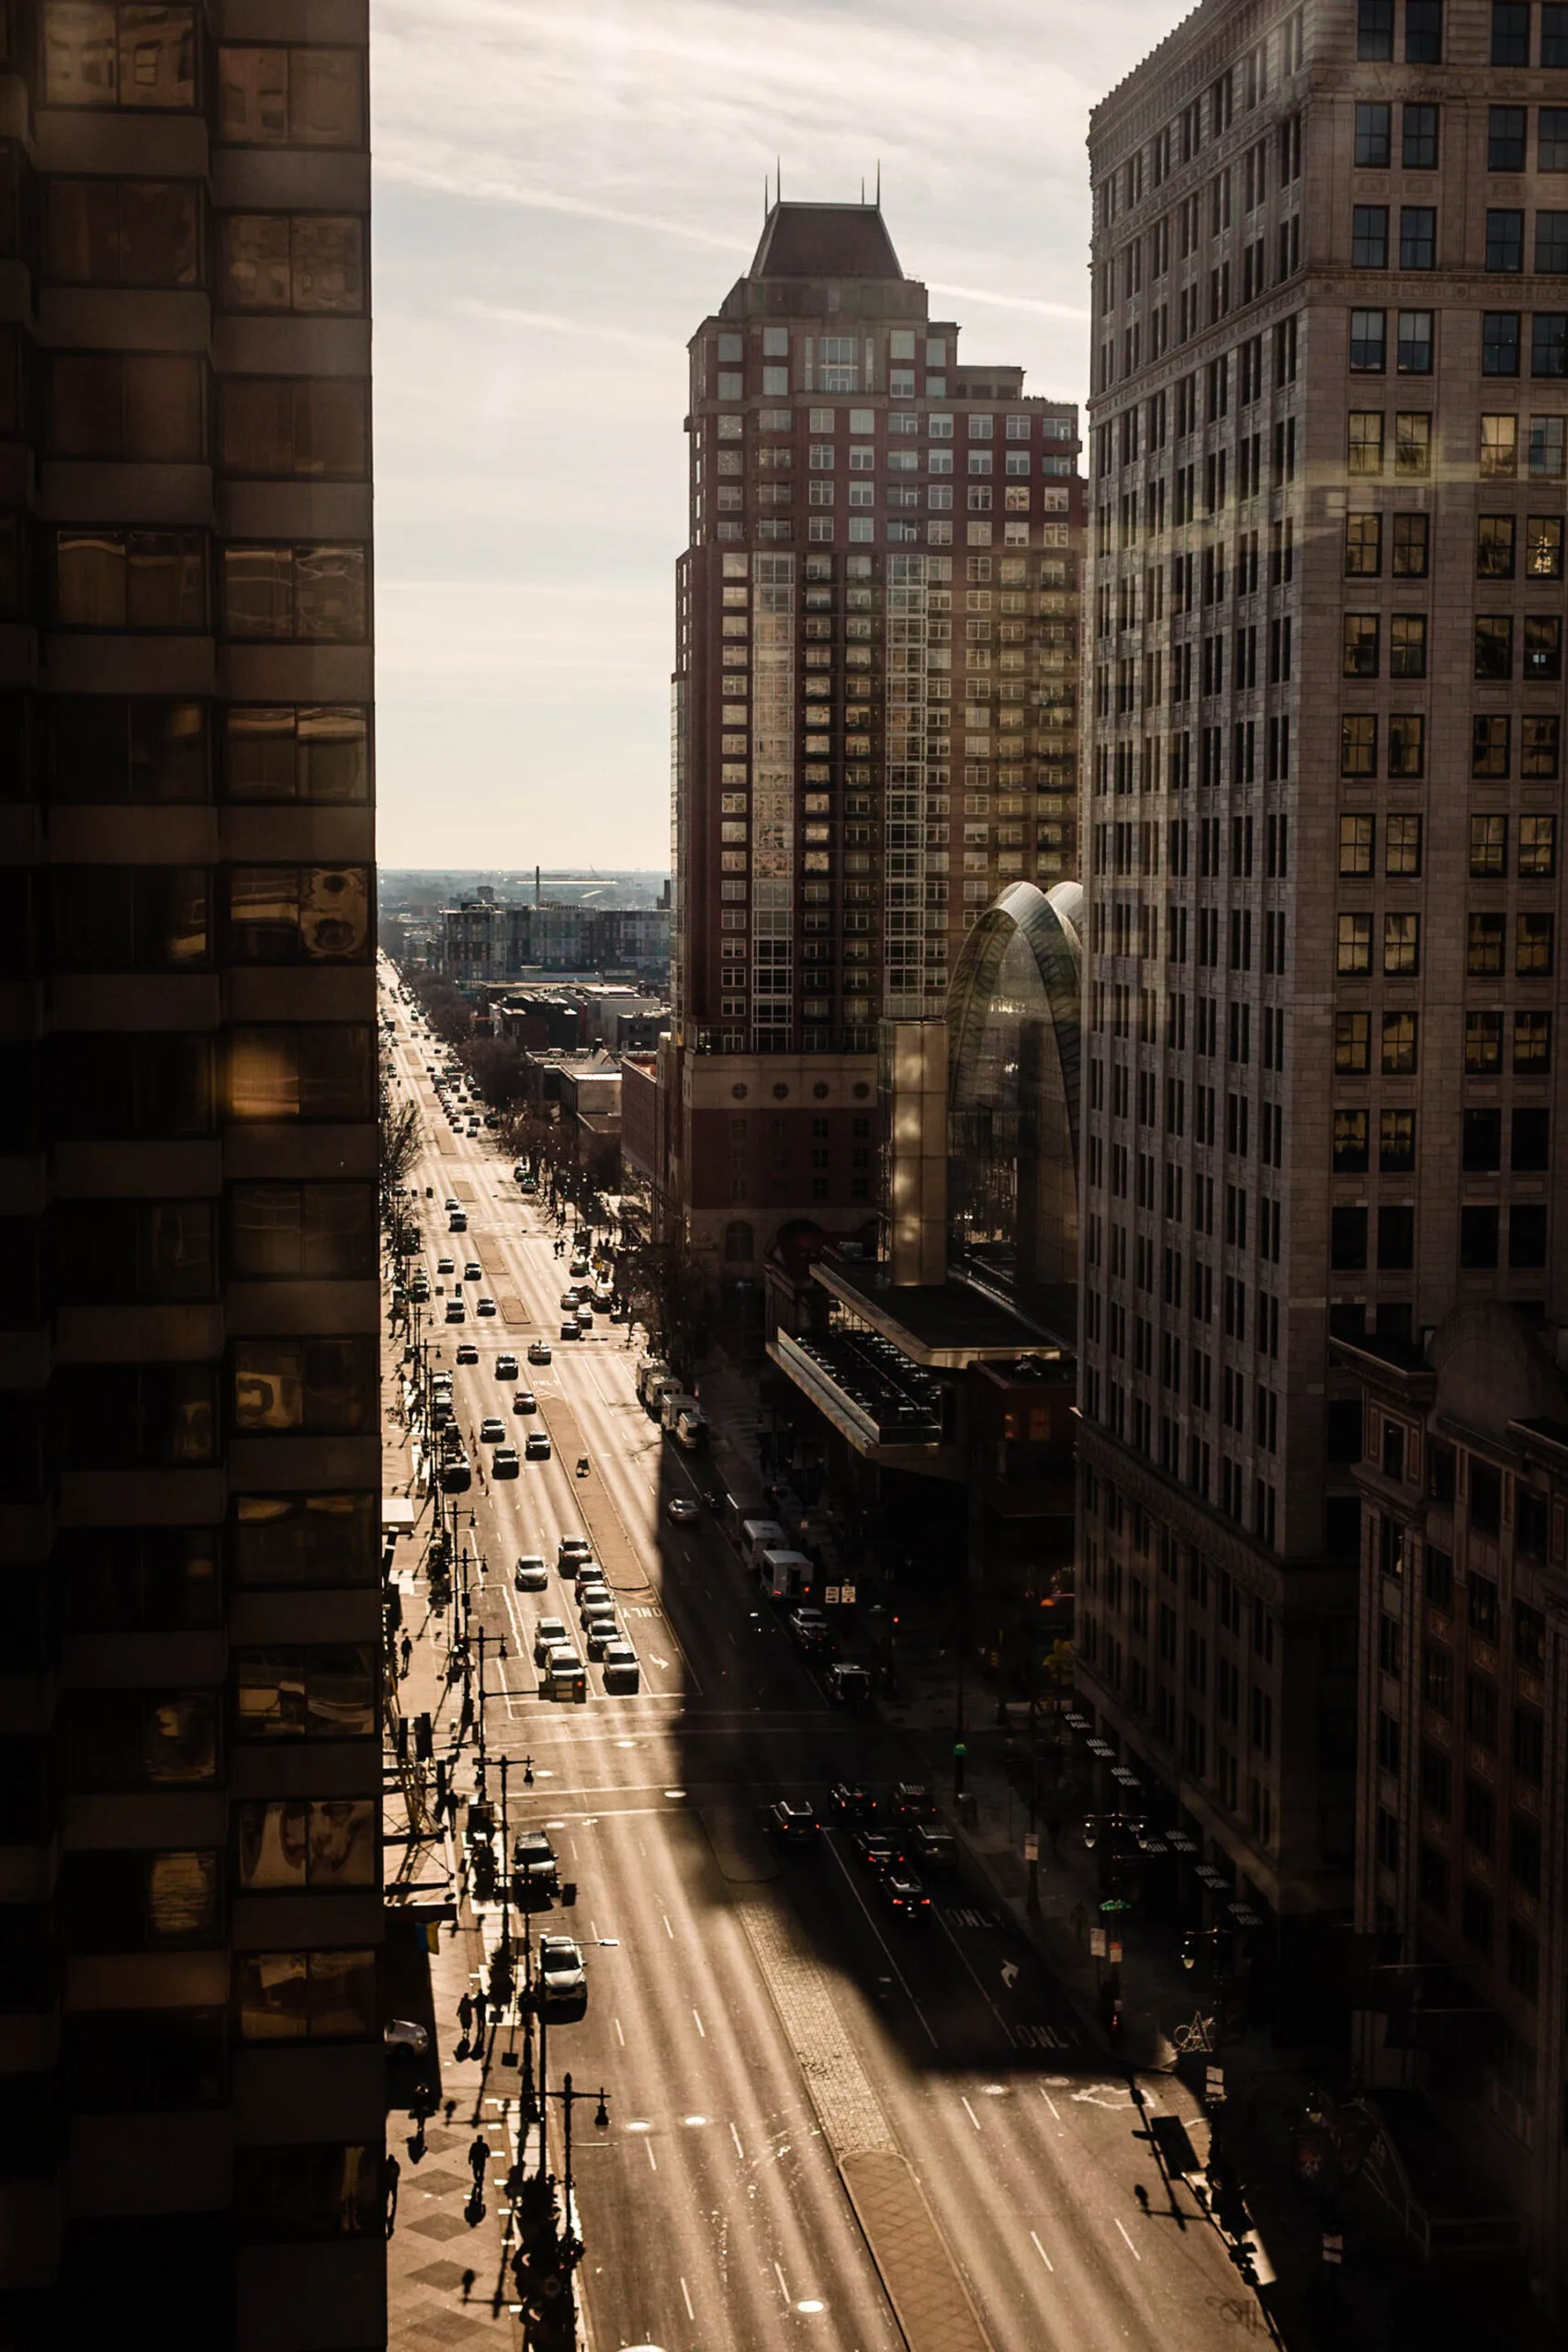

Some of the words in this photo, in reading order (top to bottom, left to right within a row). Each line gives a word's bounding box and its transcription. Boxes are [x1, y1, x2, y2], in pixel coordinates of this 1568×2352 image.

[622, 1607, 662, 1618] ONLY
[944, 1908, 1006, 1928] ONLY
[1014, 2024, 1084, 2049] ONLY
